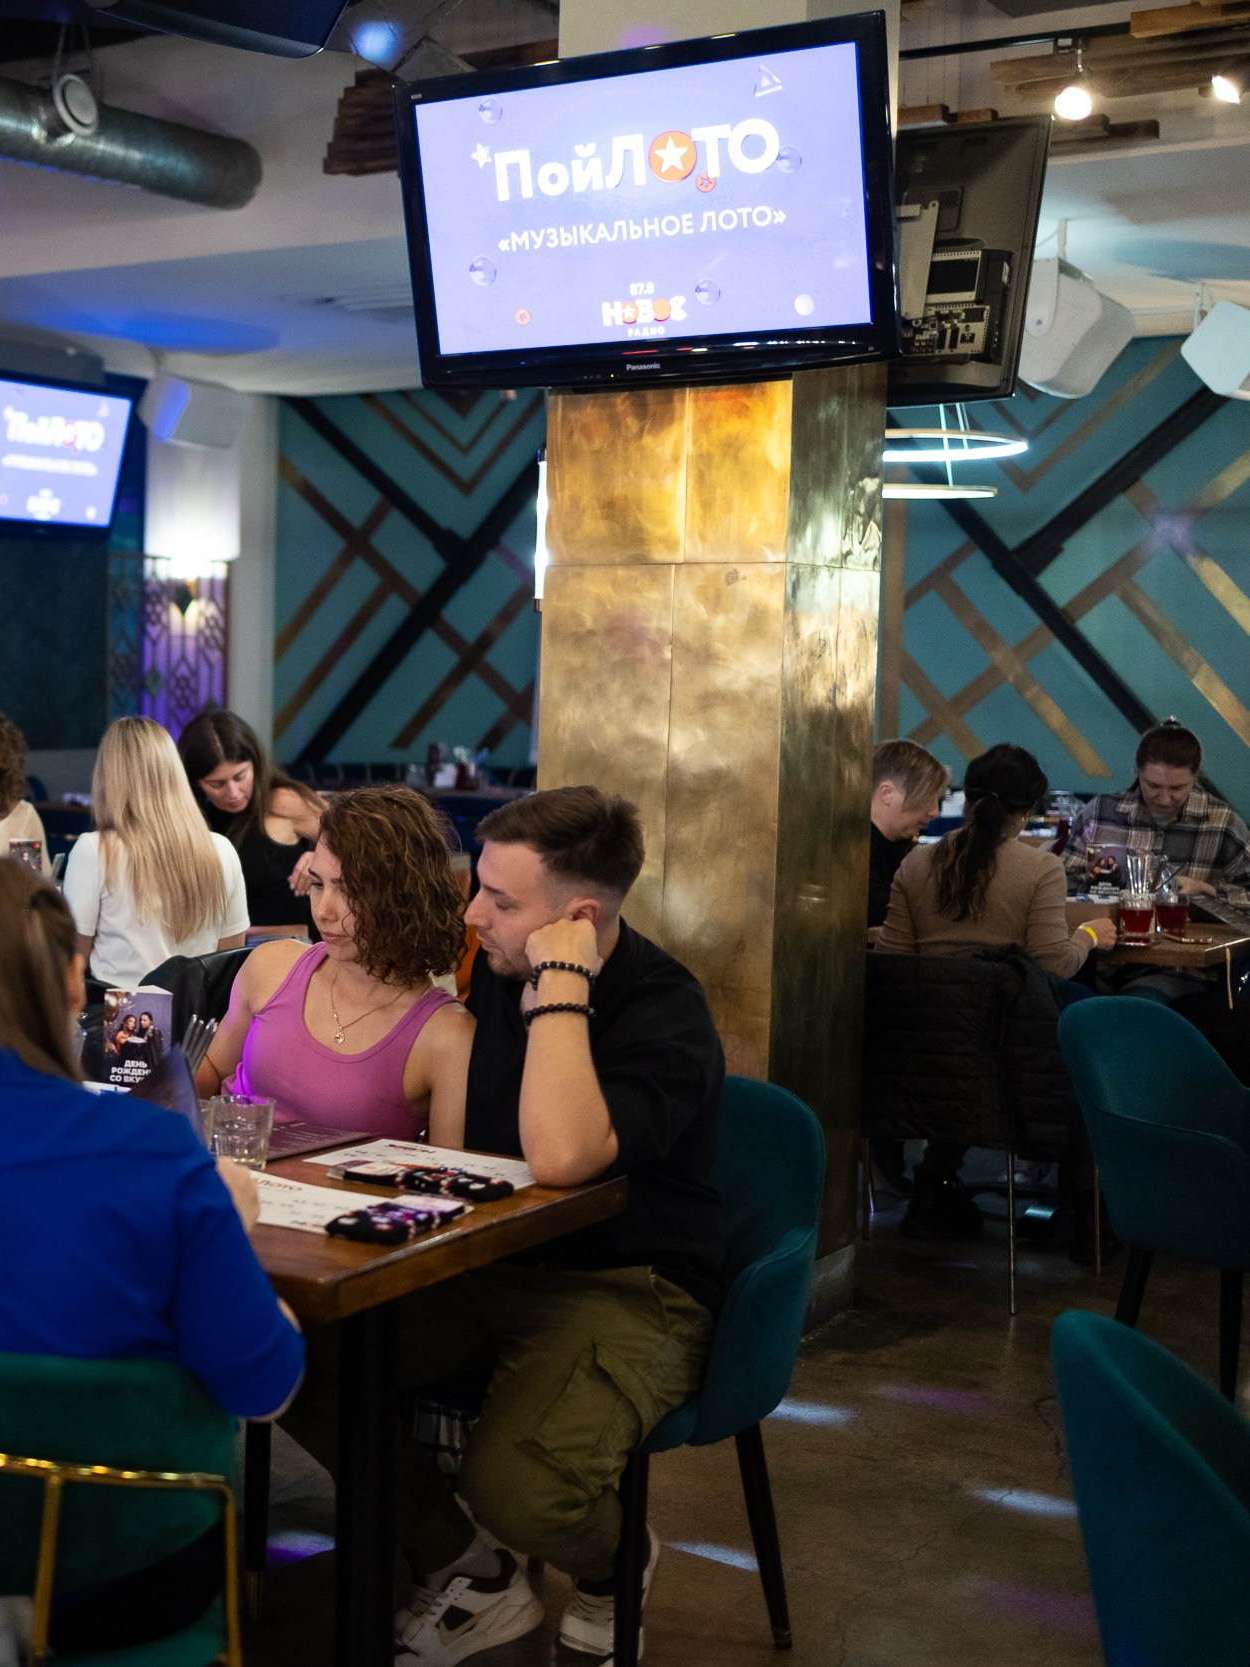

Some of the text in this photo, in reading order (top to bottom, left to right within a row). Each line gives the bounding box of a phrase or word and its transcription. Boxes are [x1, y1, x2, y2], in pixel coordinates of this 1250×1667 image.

[498, 205, 787, 252] «МУЗЫКАЛЬНОЕ ЛОТО»
[627, 326, 666, 337] РАДИО
[626, 362, 661, 371] Panasonic
[124, 1060, 148, 1068] ДЕНЬ
[110, 1074, 123, 1082] СО
